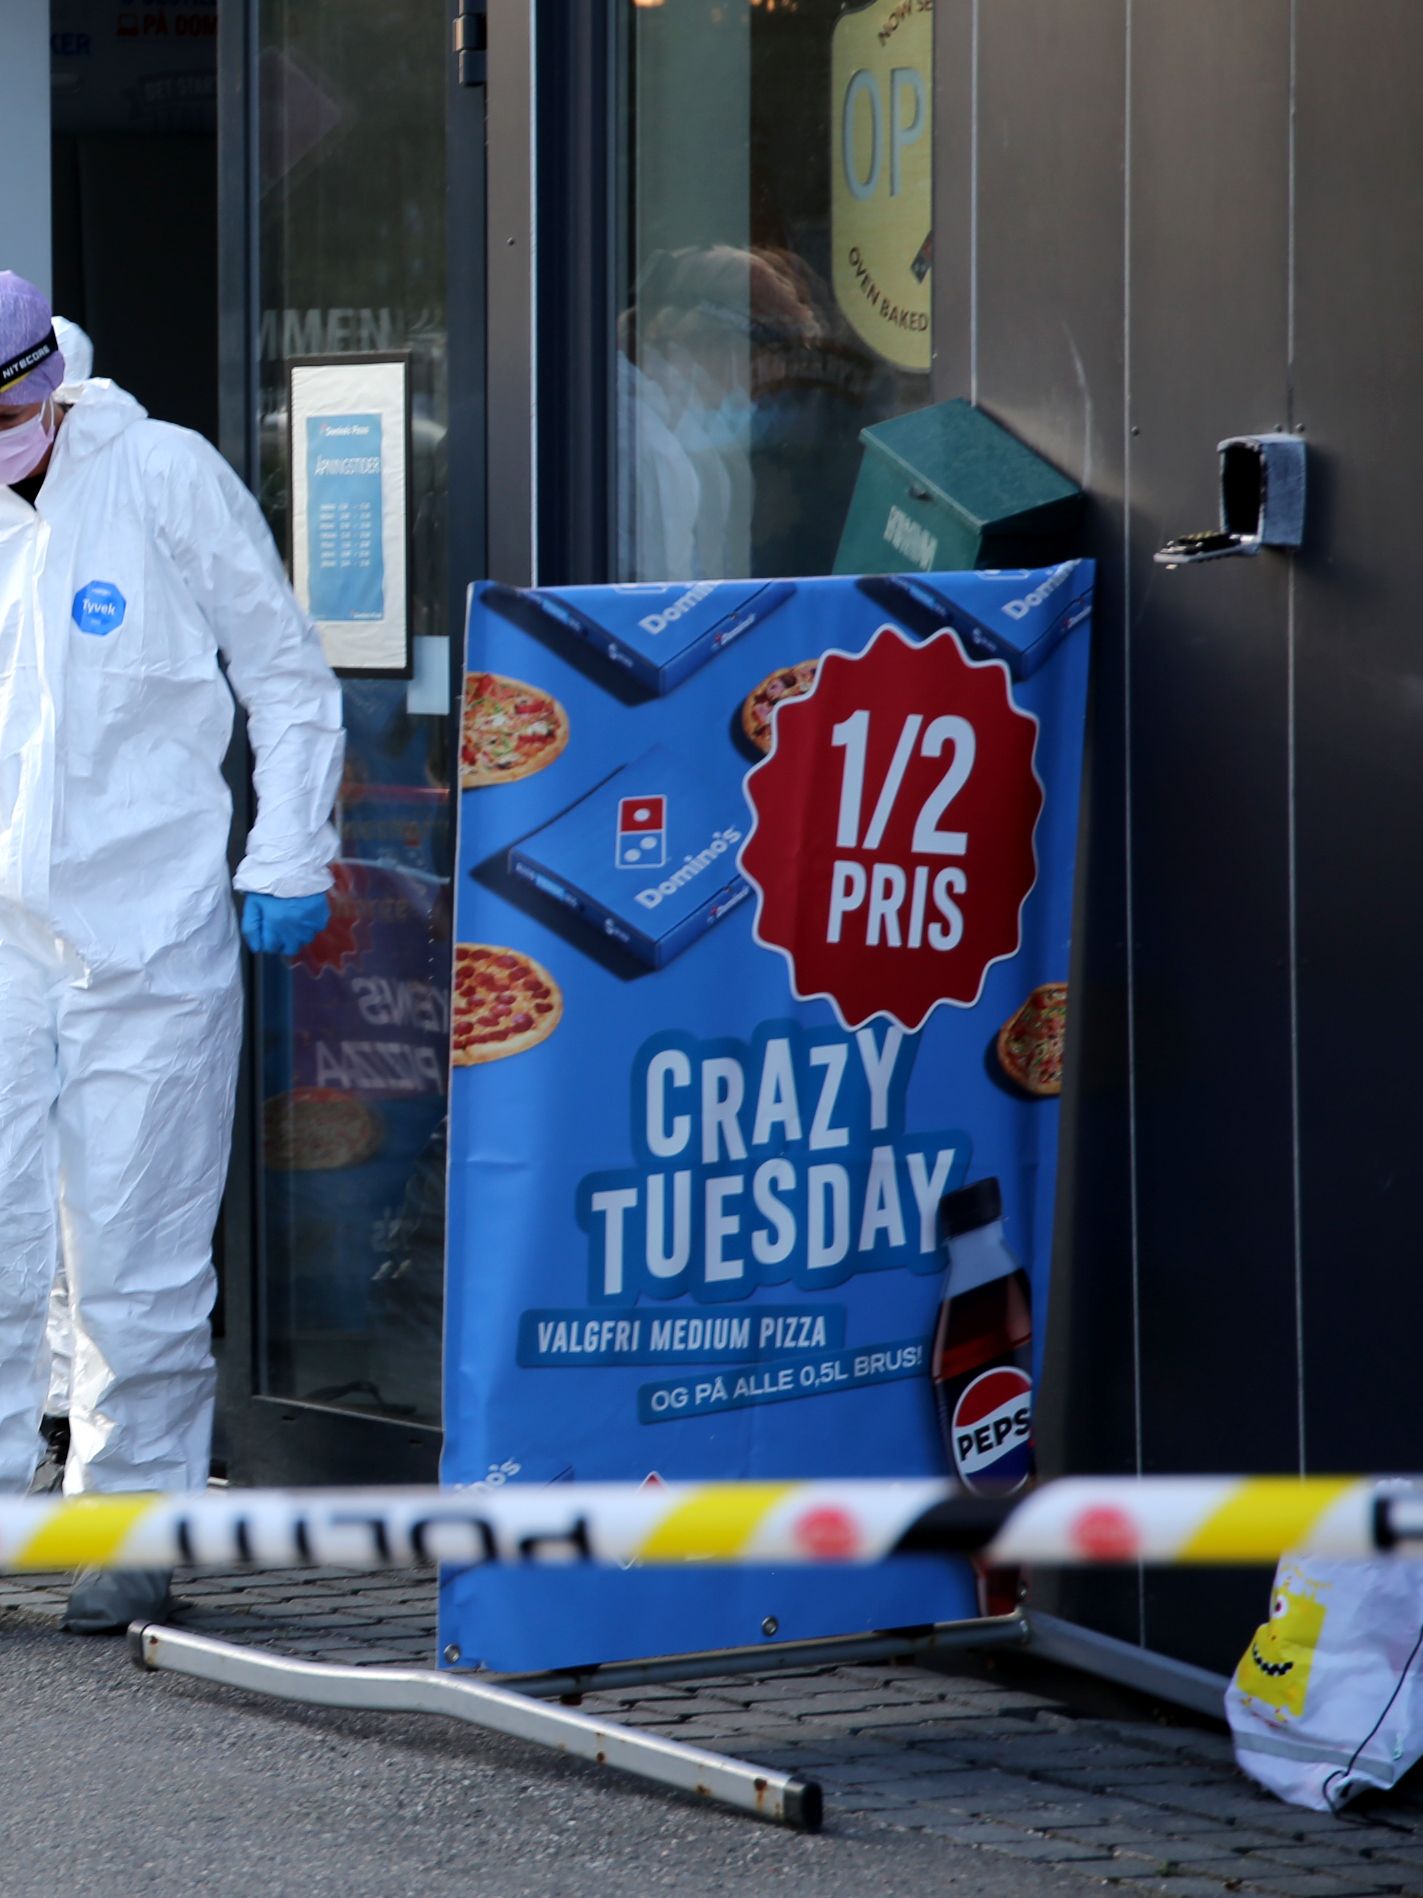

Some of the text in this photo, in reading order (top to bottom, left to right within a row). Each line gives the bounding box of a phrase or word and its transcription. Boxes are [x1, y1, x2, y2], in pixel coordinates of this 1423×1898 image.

[849, 247, 928, 332] OVEN BAKED
[82, 598, 116, 617] Tyvek
[831, 709, 976, 856] 1/2
[633, 825, 742, 909] Domino's
[826, 860, 968, 952] PRIS
[646, 1026, 903, 1165] CRAZY
[591, 1145, 956, 1296] TUESDAY
[537, 1315, 827, 1354] VALGFRI MEDIUM PIZZA
[650, 1345, 923, 1412] OG PÅ ALLE 0,5L BRUS!
